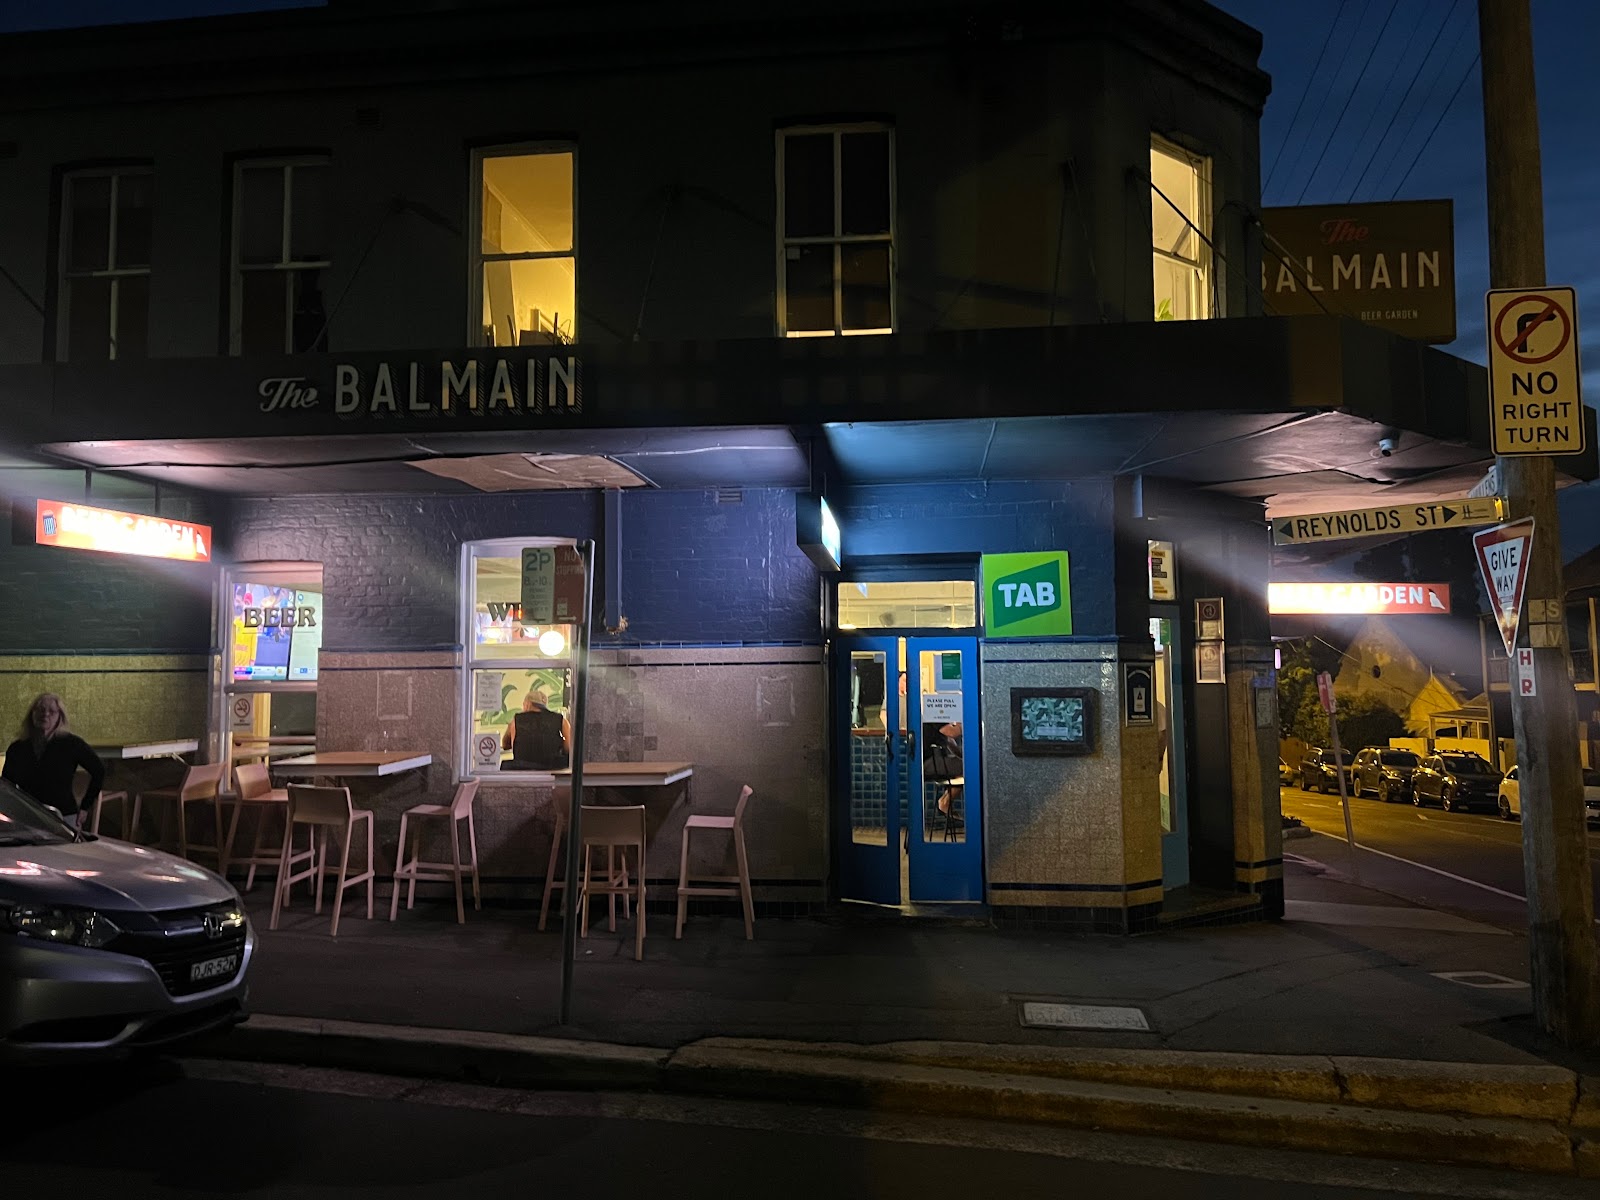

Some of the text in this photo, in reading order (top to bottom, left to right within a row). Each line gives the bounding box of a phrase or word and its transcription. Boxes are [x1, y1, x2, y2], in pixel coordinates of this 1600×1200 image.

[1319, 218, 1369, 245] The
[1261, 251, 1440, 293] ALMAIN
[1361, 310, 1418, 320] BEER GARDEN
[258, 356, 579, 415] The BALMAIN
[1512, 371, 1558, 395] NO
[1503, 402, 1571, 419] RIGHT
[1505, 426, 1569, 443] TURN
[1296, 509, 1401, 539] REYNOLDS
[1416, 505, 1438, 526] ST
[525, 552, 551, 571] 2P
[1491, 547, 1517, 571] GIVE
[998, 581, 1056, 608] TAB
[1496, 574, 1514, 593] WAY
[244, 606, 316, 627] BEER
